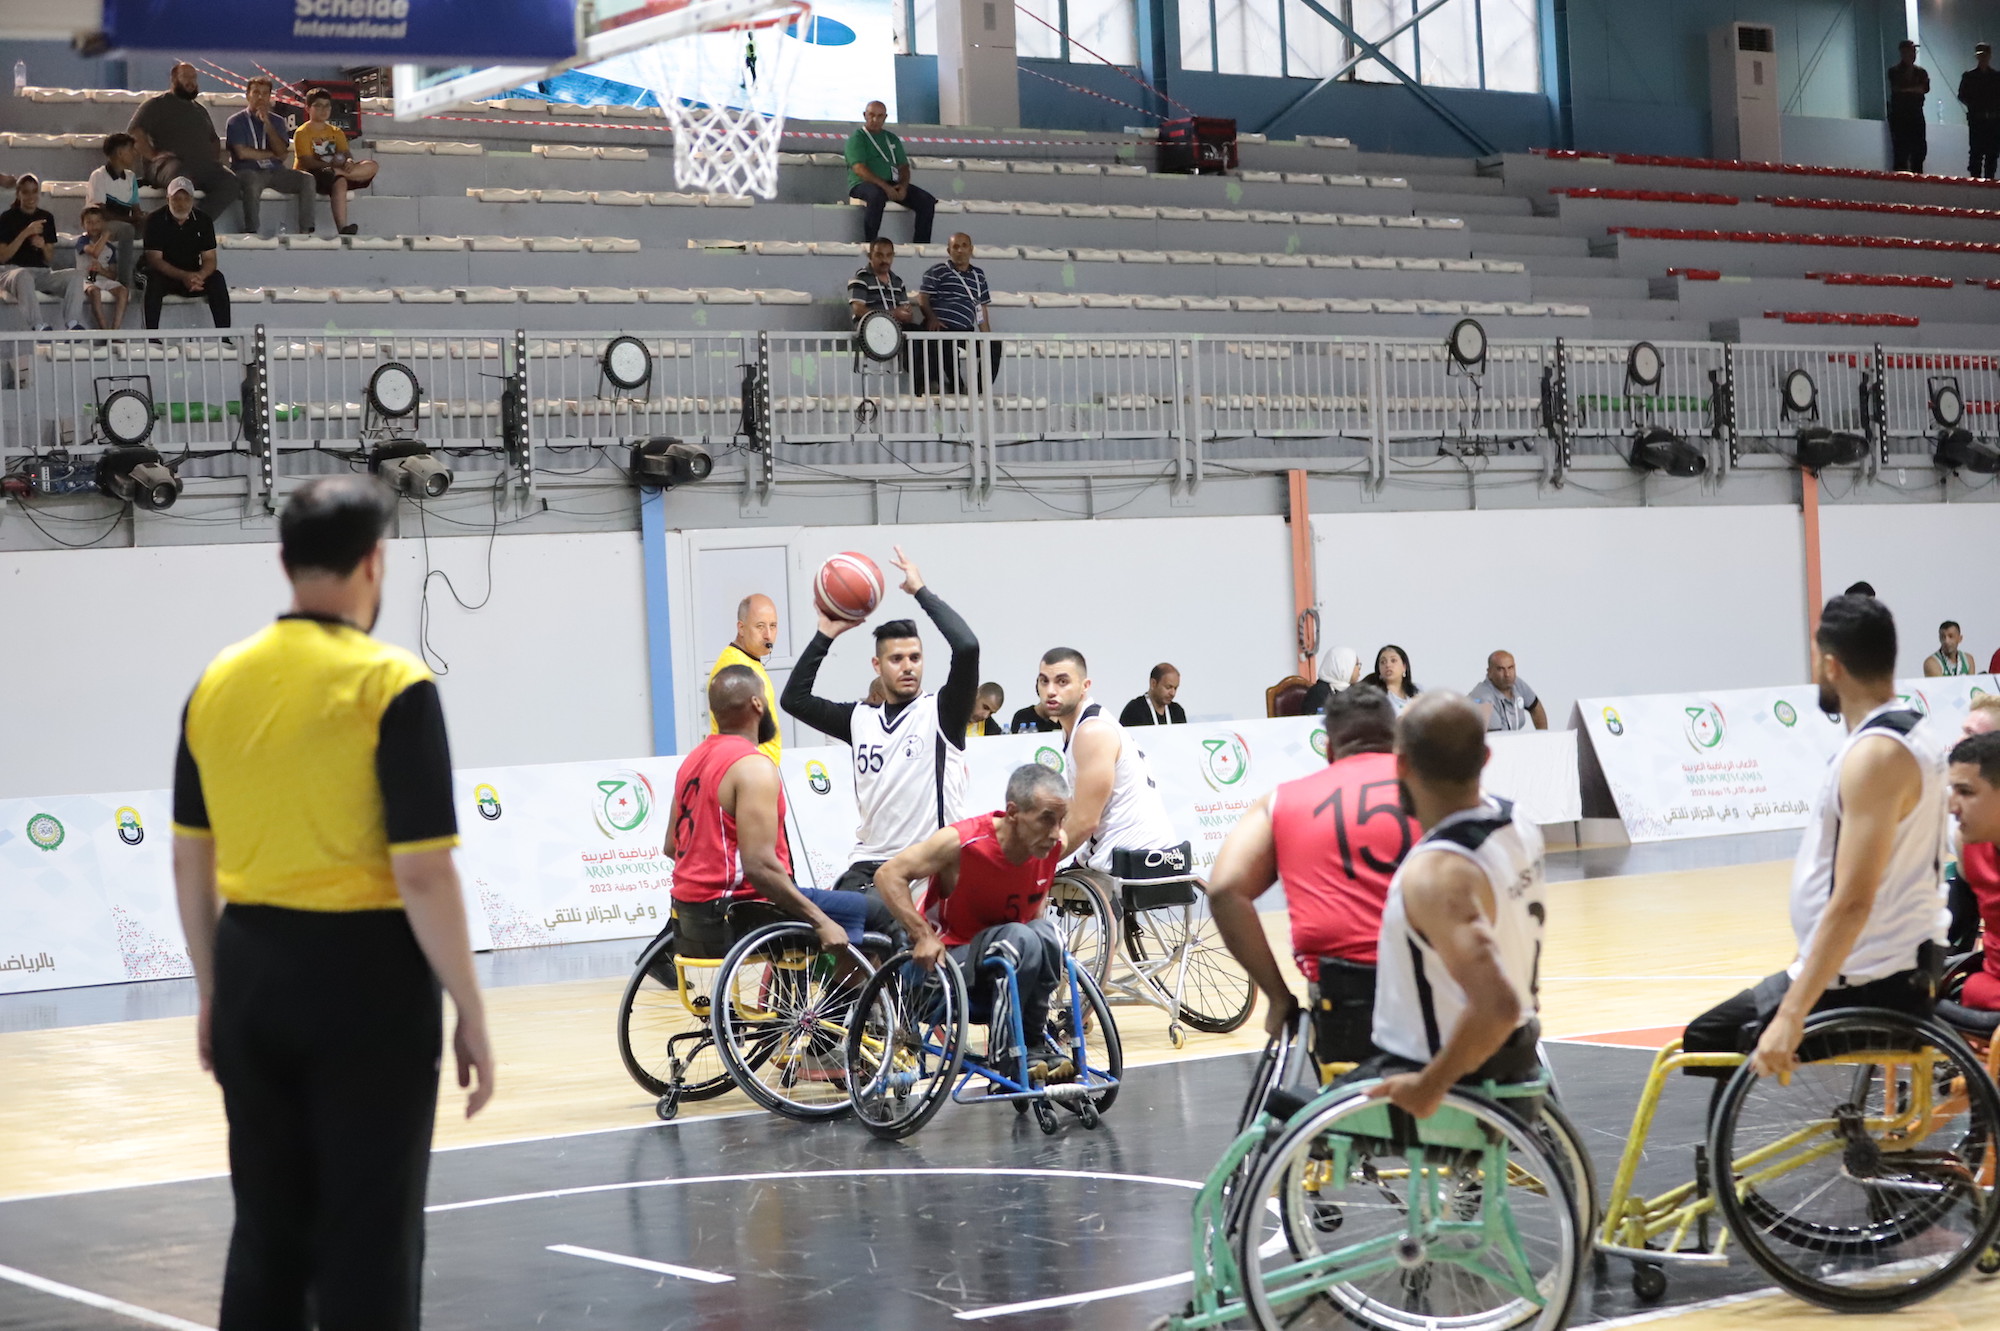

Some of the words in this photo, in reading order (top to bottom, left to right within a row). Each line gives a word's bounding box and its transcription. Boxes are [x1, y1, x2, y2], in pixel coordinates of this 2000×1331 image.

[293, 19, 407, 38] International
[857, 744, 884, 774] 55
[1313, 779, 1411, 881] 15
[581, 849, 616, 864] العربية
[618, 846, 659, 861] الرياضية
[584, 864, 614, 879] ARAB
[615, 861, 659, 876] SPORTS
[590, 883, 612, 893] 2023
[639, 880, 649, 889] 15
[544, 907, 582, 931] نلتقي
[585, 904, 621, 924] الجزائر
[0, 952, 55, 973] بالرياض
